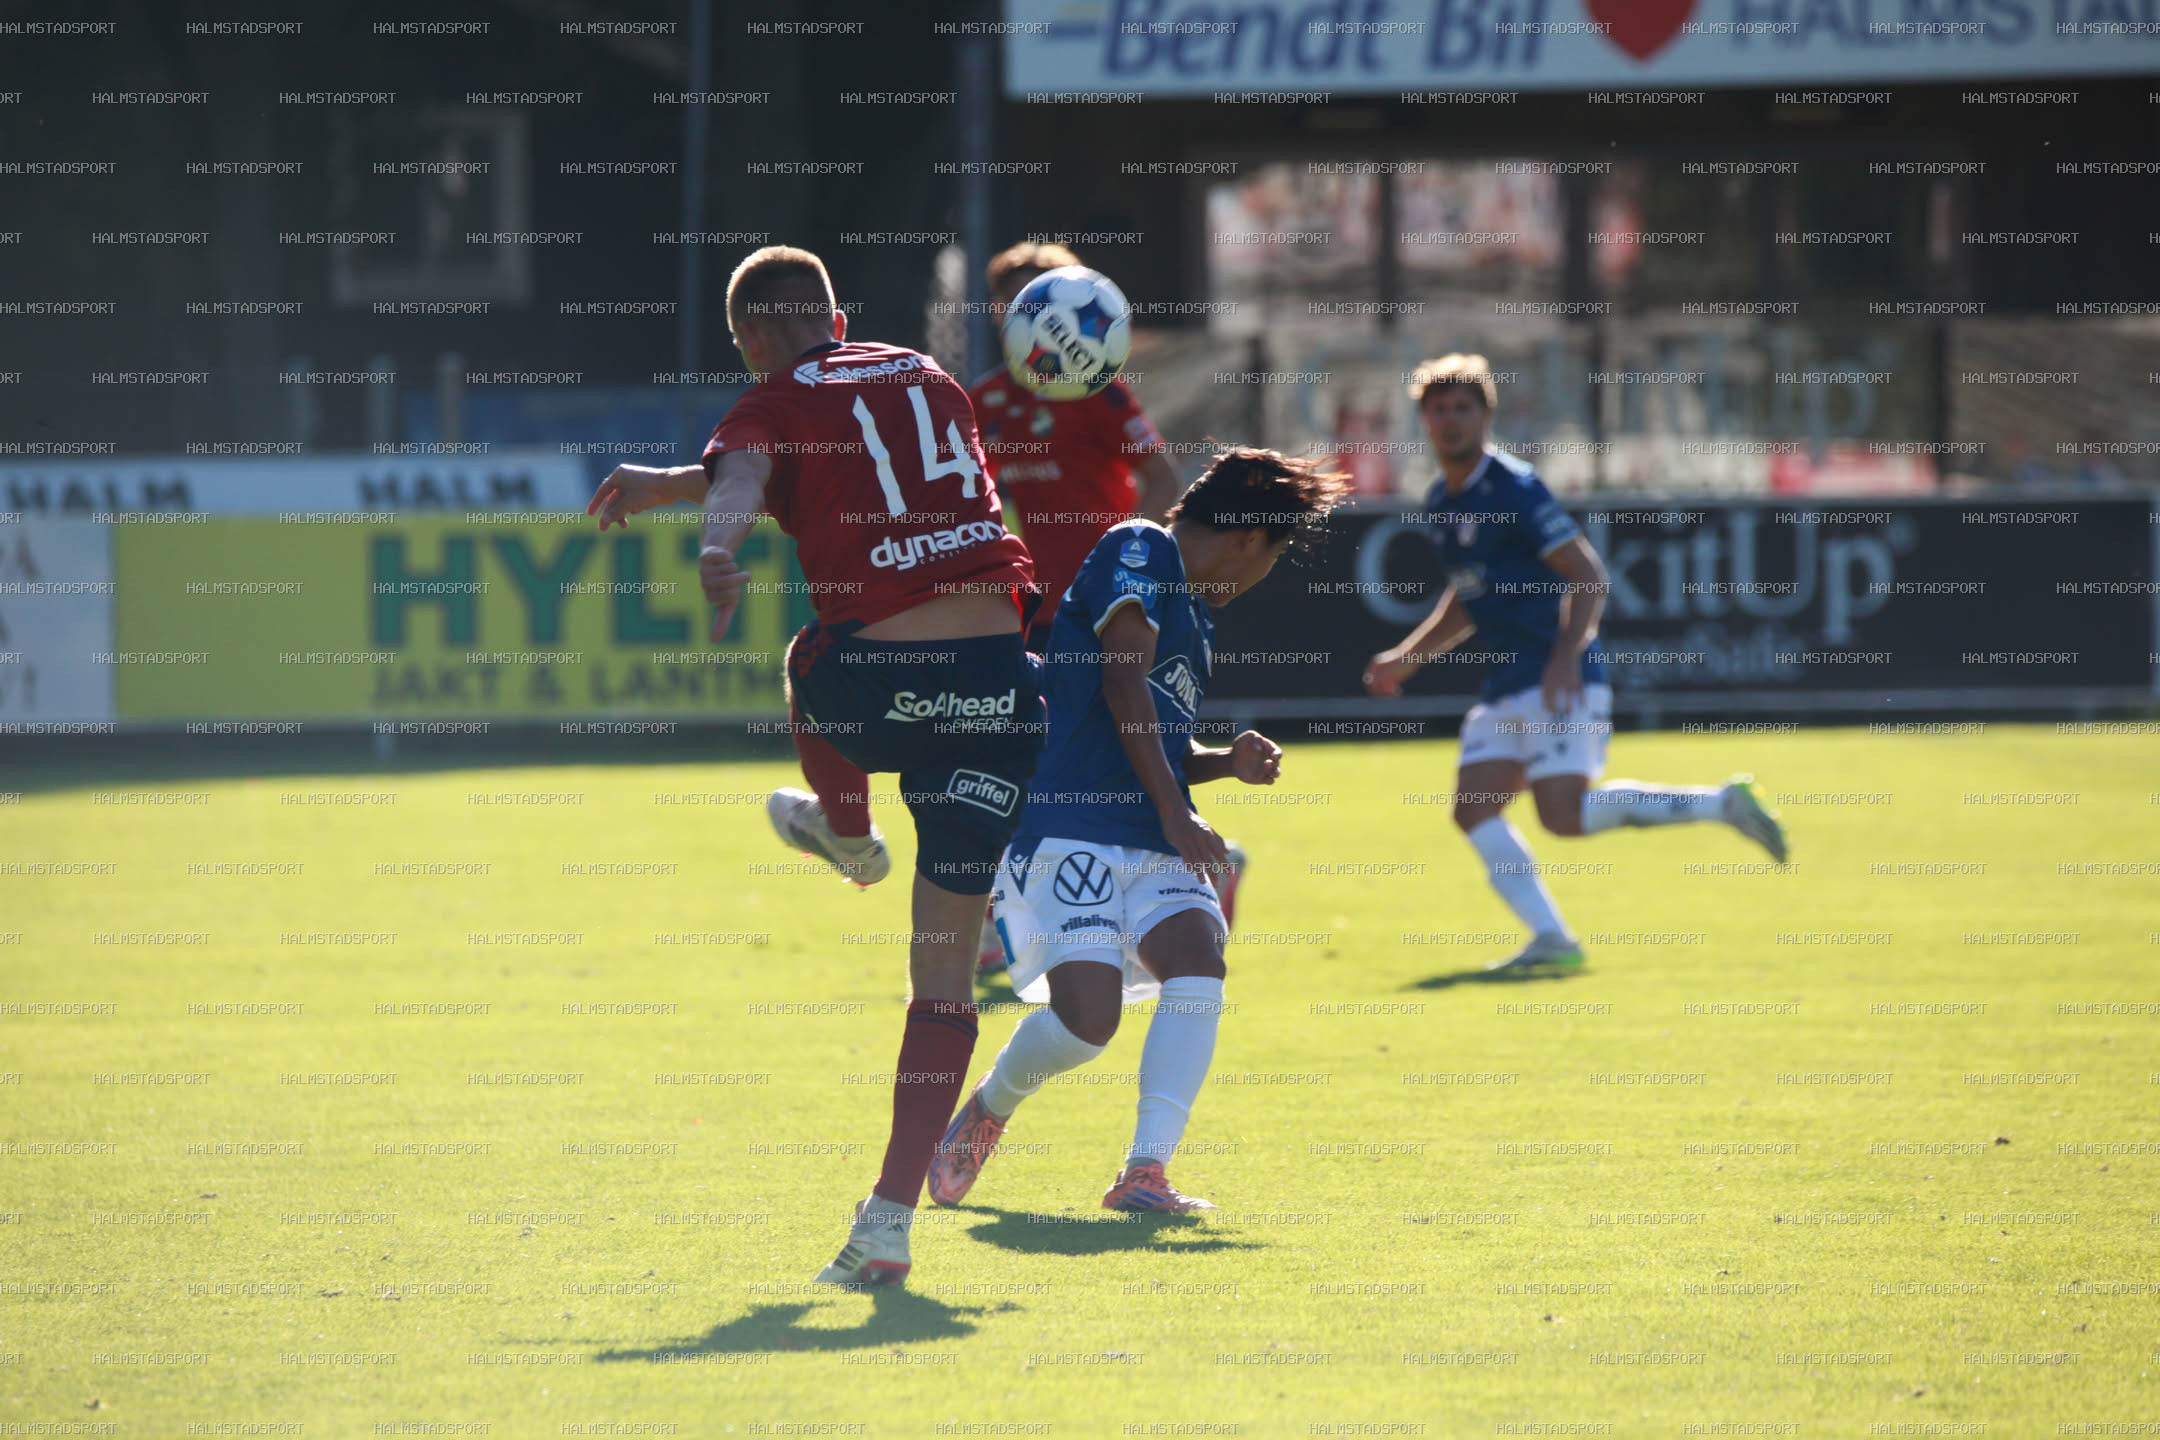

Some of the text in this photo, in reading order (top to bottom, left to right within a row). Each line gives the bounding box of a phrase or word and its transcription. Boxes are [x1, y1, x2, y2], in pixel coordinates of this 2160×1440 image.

[853, 385, 982, 518] 14
[870, 520, 1004, 571] dynacon
[894, 688, 1017, 718] GoAhead
[956, 778, 1010, 806] griffel
